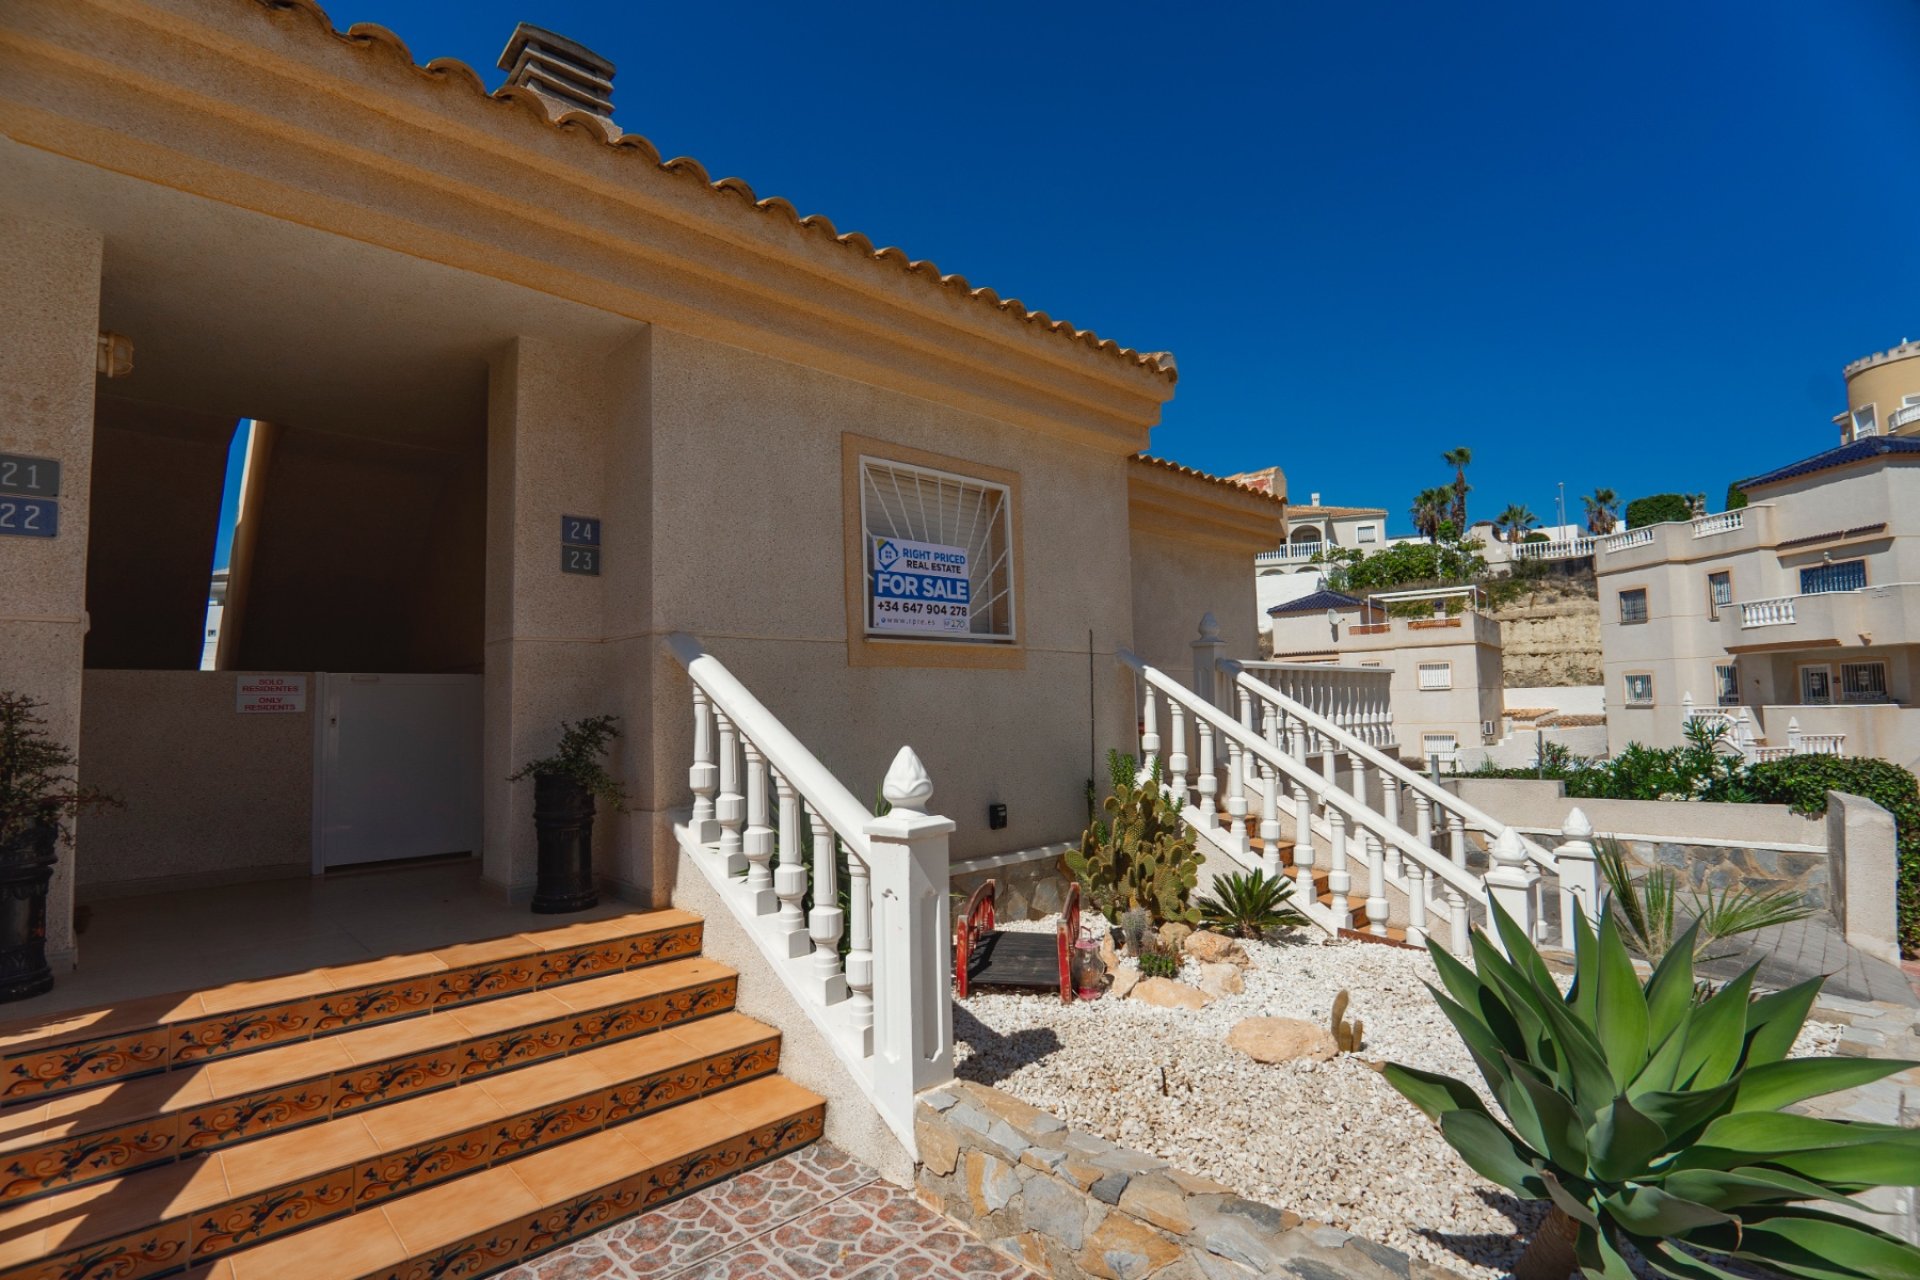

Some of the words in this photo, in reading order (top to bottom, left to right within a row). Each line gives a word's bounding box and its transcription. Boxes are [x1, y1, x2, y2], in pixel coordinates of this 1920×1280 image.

[2, 462, 40, 489] 21
[0, 503, 40, 529] 22
[571, 522, 592, 540] 24
[571, 551, 592, 570] 23
[902, 548, 931, 561] RIGHT
[934, 552, 965, 564] PRICED
[906, 560, 929, 569] REAL
[931, 562, 961, 574] ESTATE
[878, 574, 918, 596] FOR
[922, 578, 967, 600] SALE
[878, 601, 899, 612] +34
[903, 602, 923, 614] 647
[927, 604, 947, 615] 904
[950, 606, 967, 617] 278
